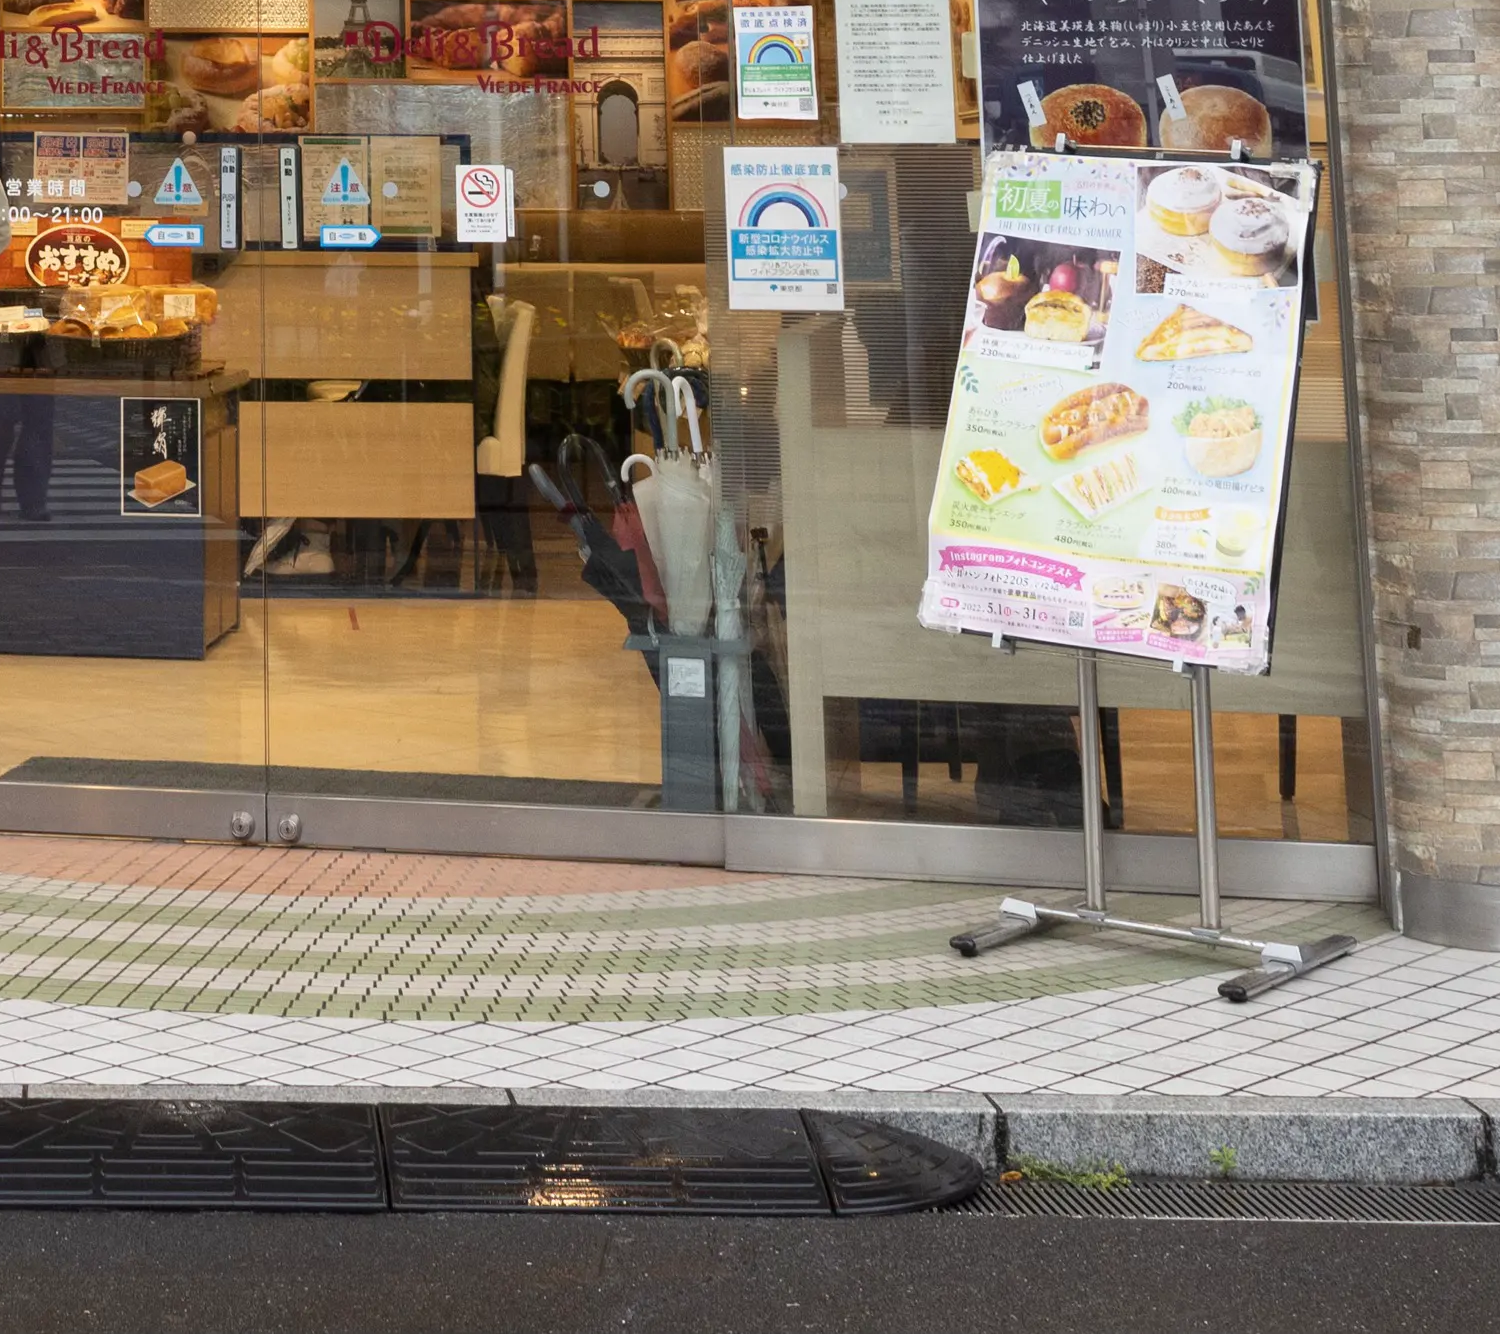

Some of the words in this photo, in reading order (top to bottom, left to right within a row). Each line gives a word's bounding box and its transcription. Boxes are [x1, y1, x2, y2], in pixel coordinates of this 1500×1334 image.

[740, 17, 807, 29] 徹底点検済
[24, 35, 49, 69] &
[51, 23, 165, 63] Bread
[362, 20, 445, 64] Deli
[453, 32, 479, 68] &
[477, 20, 600, 62] Bread
[1021, 34, 1266, 49] デニッシュ生地で包み、外はカリッと中はしっとりと
[1022, 52, 1083, 65] 仕上げました
[47, 76, 73, 95] VIE
[77, 81, 98, 95] DE
[101, 76, 165, 95] FRANCE
[476, 74, 505, 94] VIE
[508, 80, 531, 94] DE
[533, 74, 602, 94] FRANCE
[222, 155, 236, 164] AUTO
[222, 165, 236, 174] 自動
[284, 157, 293, 177] 自動
[730, 163, 833, 177] 感染防止徹底宣言
[5, 178, 86, 198] 営業時間
[163, 182, 193, 193] 注意
[330, 182, 360, 193] 注意
[222, 193, 236, 202] PUSH
[998, 182, 1127, 221] 初夏の味わい
[998, 220, 1014, 231] THE
[1016, 221, 1042, 233] TASTE
[1085, 227, 1123, 240] SUMMER
[738, 232, 830, 245] 新型コロナウイルス
[745, 244, 824, 257] 感染拡大防止中
[38, 244, 121, 272] おすすめ
[57, 270, 100, 283] コーナー
[780, 284, 803, 293] 東京都
[1167, 286, 1210, 300] 270円(税込)
[979, 347, 1021, 361] 230円(税込)
[1166, 381, 1208, 393] 200円(税込)
[964, 423, 1007, 438] 350円(税込)
[1160, 486, 1203, 498] 400円(税込)
[949, 518, 992, 533] 350円(税込)
[1053, 534, 1097, 549] 480円(税込)
[950, 550, 1074, 579] Instagramフォトコンテスト
